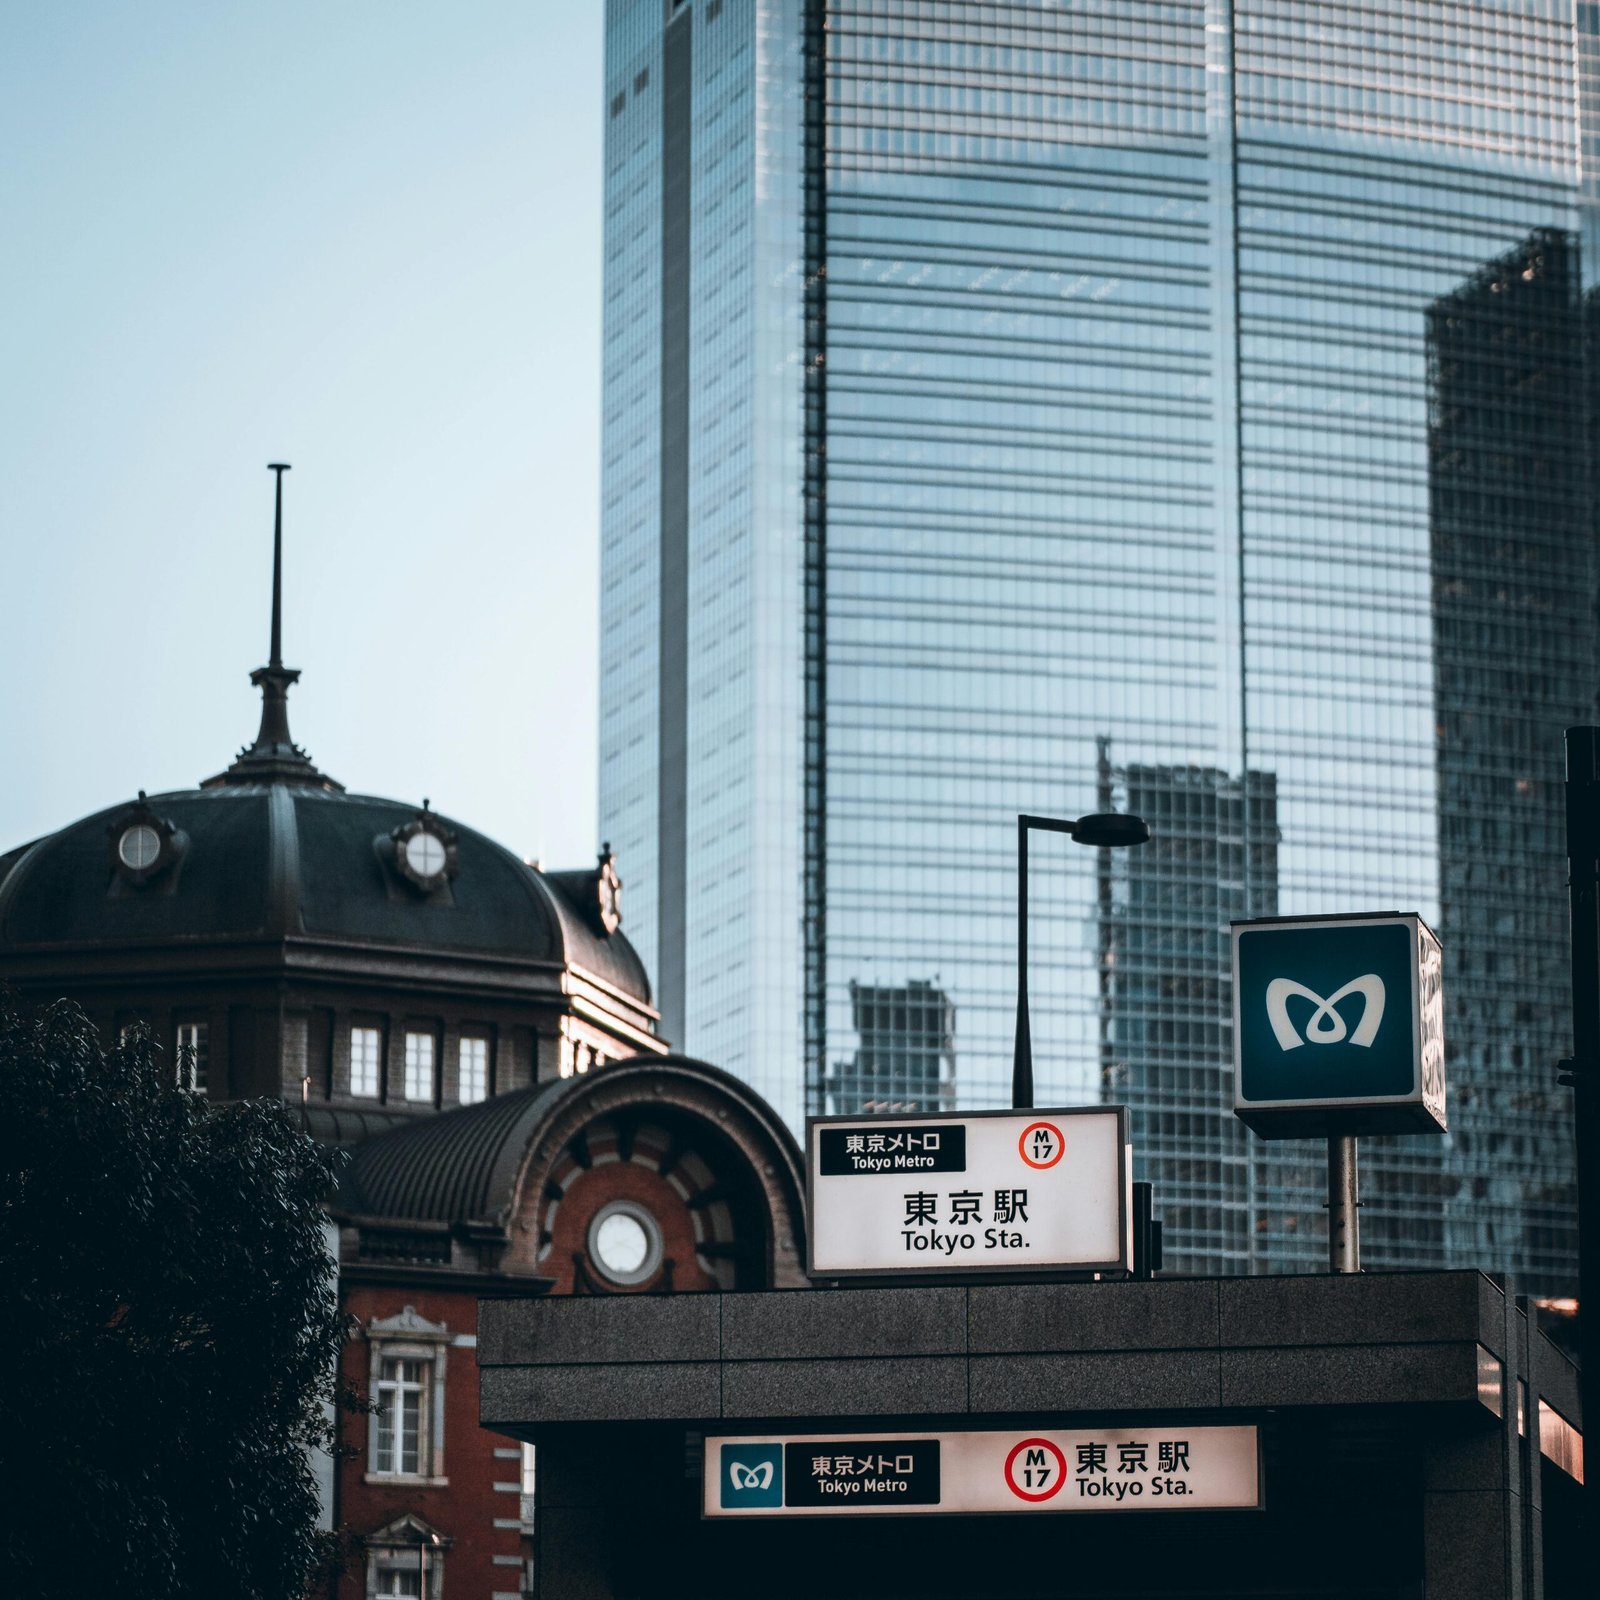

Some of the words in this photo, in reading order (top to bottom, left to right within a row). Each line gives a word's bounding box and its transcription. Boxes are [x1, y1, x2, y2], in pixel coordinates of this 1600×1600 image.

[846, 1133, 940, 1153] 東京メトロ
[1034, 1130, 1050, 1143] M
[1033, 1145, 1052, 1159] 17
[852, 1156, 892, 1172] Tokyo
[895, 1154, 935, 1168] Metro
[903, 1189, 1029, 1226] 東京駅
[901, 1229, 975, 1255] Tokyo
[984, 1228, 1030, 1249] Sta.
[811, 1455, 914, 1476] 東京メトロ
[1026, 1449, 1046, 1466] M
[1076, 1441, 1190, 1473] 東京駅
[818, 1479, 861, 1495] Tokyo
[865, 1478, 908, 1492] Metro
[1024, 1469, 1051, 1488] 17
[1076, 1477, 1144, 1501] Tokyo
[1151, 1477, 1193, 1495] Sta.
